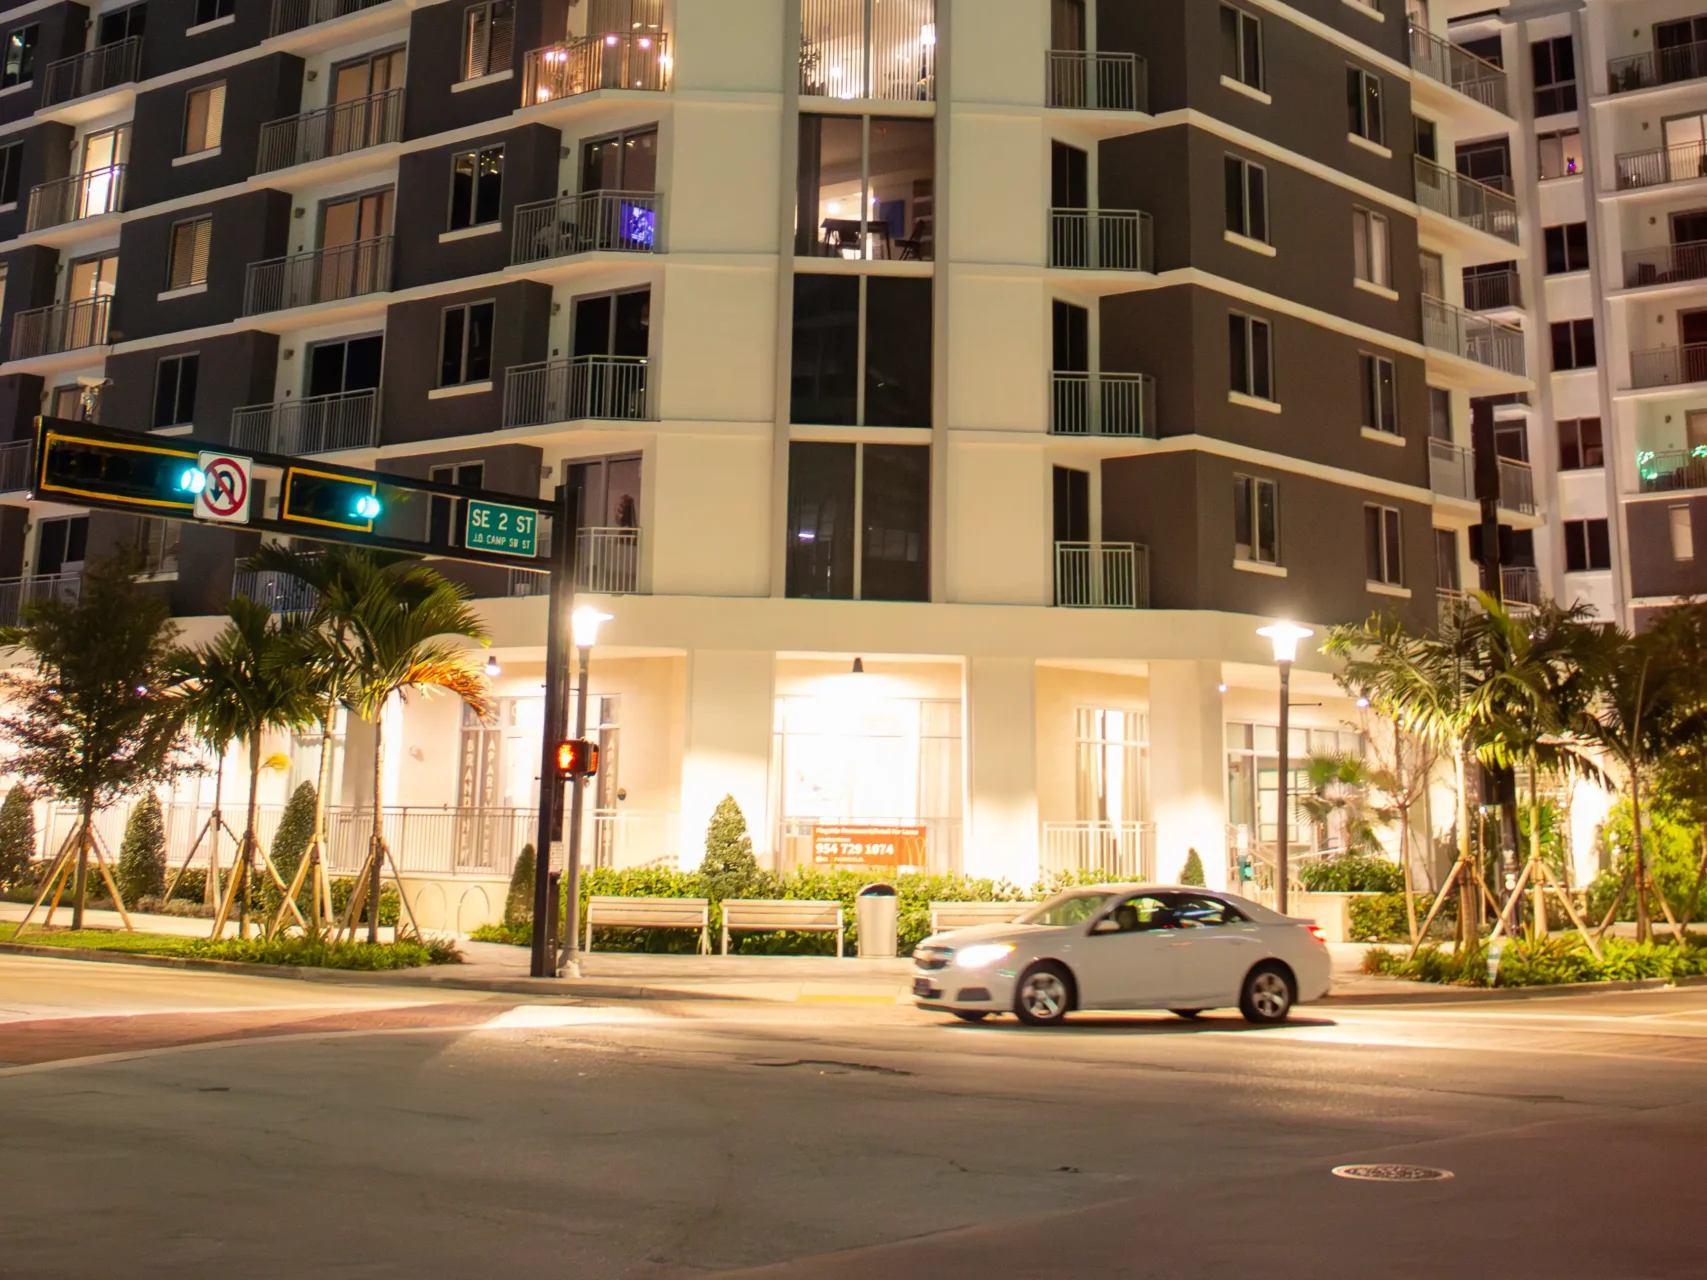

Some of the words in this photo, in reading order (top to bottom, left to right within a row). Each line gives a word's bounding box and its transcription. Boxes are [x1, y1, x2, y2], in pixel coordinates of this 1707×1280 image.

[472, 509, 490, 528] SE
[498, 512, 508, 531] 2
[516, 515, 533, 534] ST
[486, 534, 506, 546] CAMP
[522, 540, 530, 549] ST
[463, 739, 474, 808] BRAND
[815, 843, 838, 855] 954
[840, 843, 863, 855] 729
